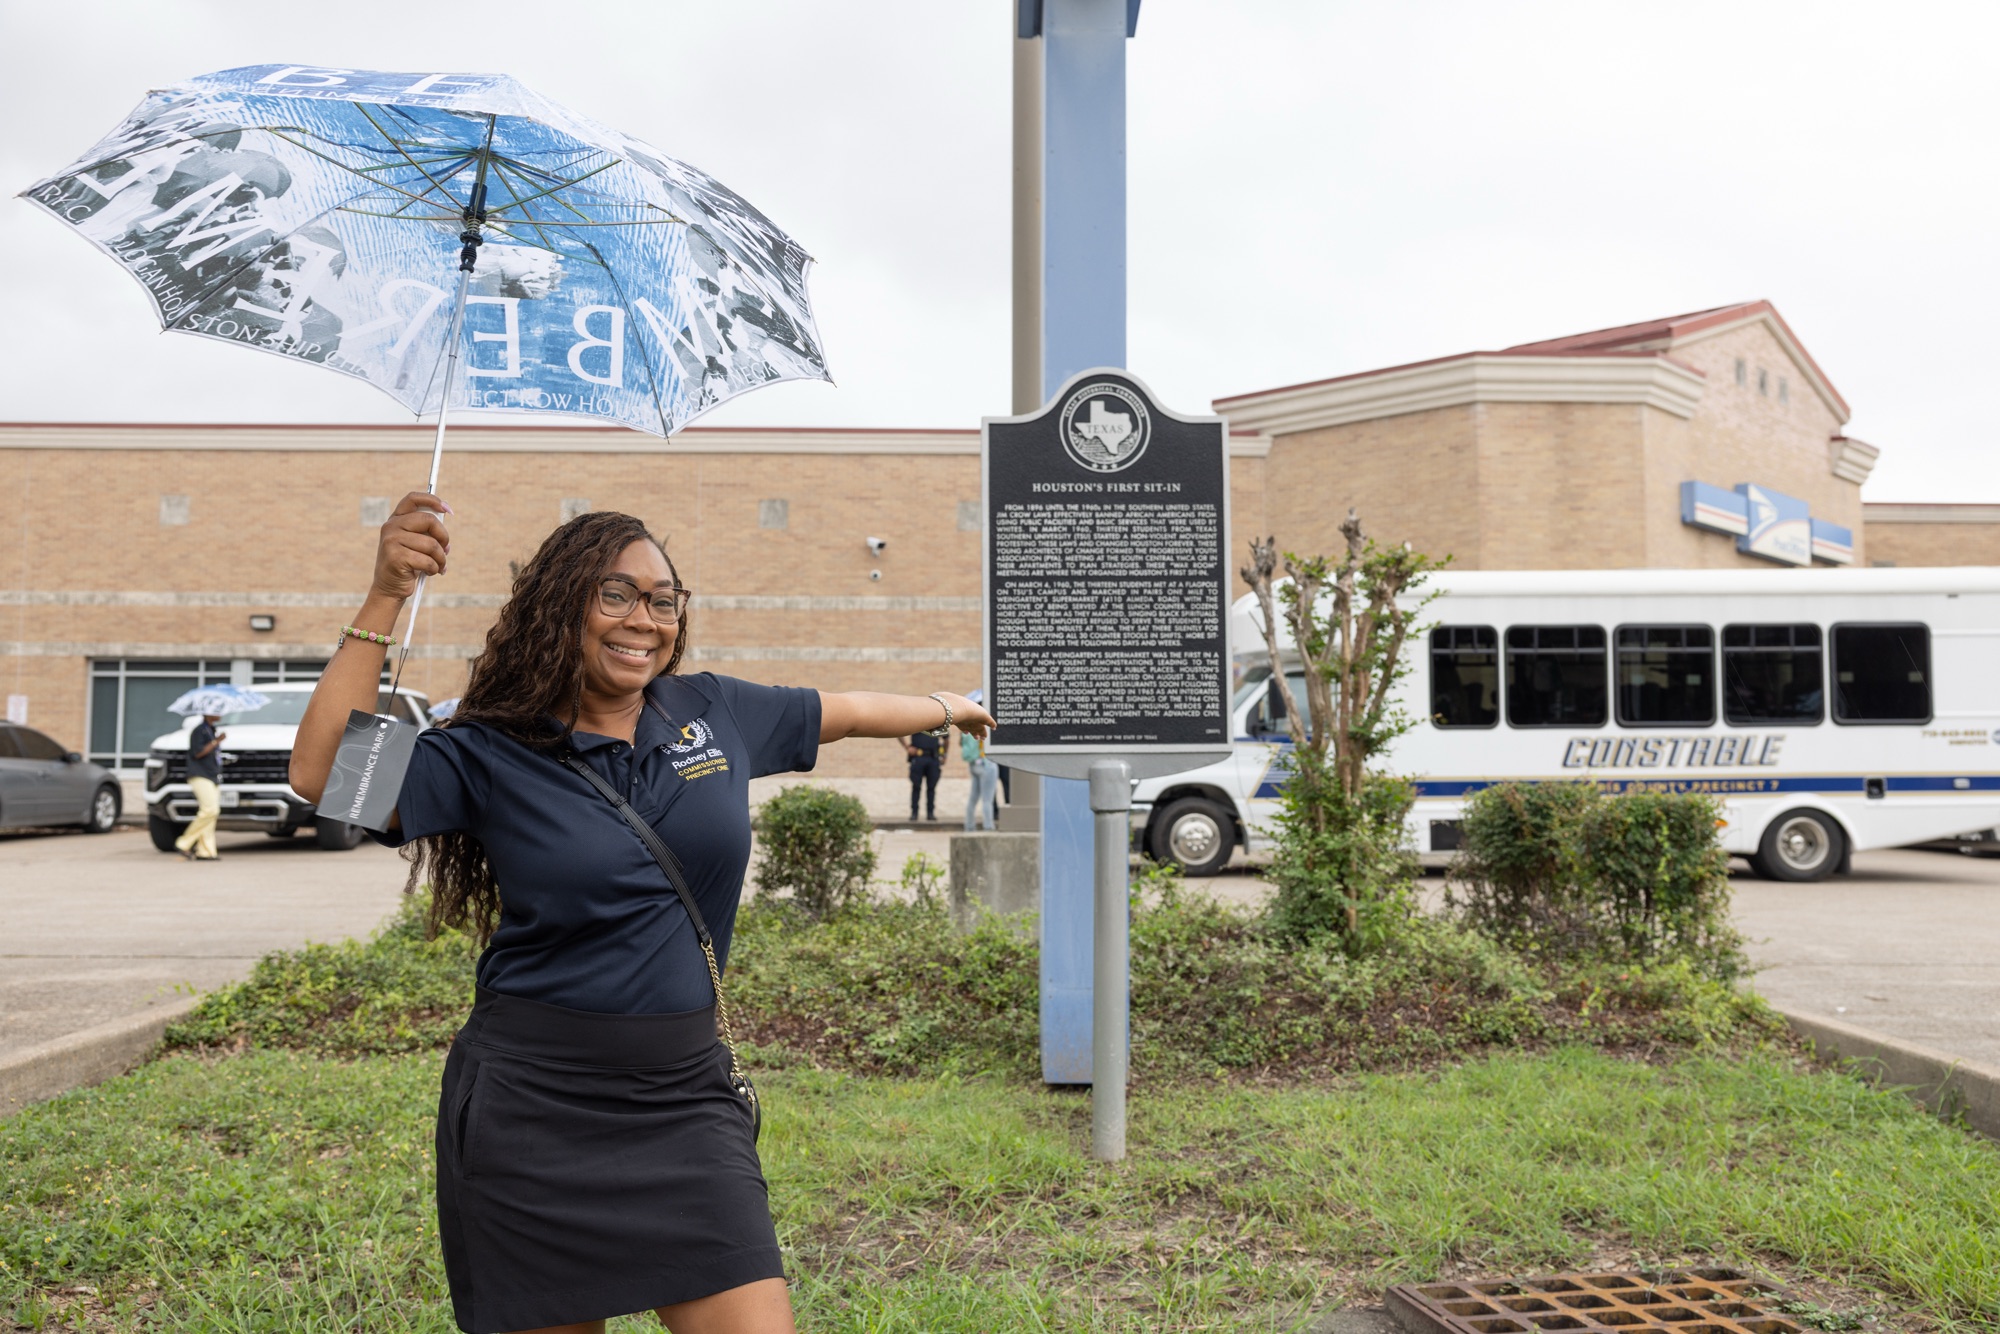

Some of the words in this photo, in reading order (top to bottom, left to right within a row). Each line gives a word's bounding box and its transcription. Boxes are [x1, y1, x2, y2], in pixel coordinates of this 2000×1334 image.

[520, 390, 572, 410] ROW
[1086, 424, 1124, 435] TEXAS
[1032, 483, 1104, 492] HOUSTON'S
[1106, 483, 1141, 492] FIRST
[1144, 483, 1181, 492] SIT-IN
[1051, 595, 1099, 603] SUPERMARKET
[1126, 595, 1154, 603] ALMEDA
[1183, 595, 1202, 603] WITH
[1205, 595, 1218, 603] THE
[1005, 651, 1018, 659] THE
[1041, 651, 1050, 659] AT
[1104, 651, 1150, 659] SUPERMARKET
[1151, 651, 1168, 659] WAS
[1169, 651, 1182, 659] THE
[1183, 651, 1201, 659] FIRST
[1203, 651, 1212, 659] IN
[1213, 651, 1219, 659] A
[696, 717, 714, 740] COUNTY
[1562, 734, 1785, 768] CONSTABLE
[672, 752, 707, 770] Rodney
[678, 757, 728, 776] COMMISSIONER
[349, 753, 379, 819] REMEMBRANCE
[371, 730, 386, 753] PARK
[685, 767, 716, 781] PRECINCT
[1692, 780, 1765, 793] PRECINCT
[1769, 780, 1780, 791] 7
